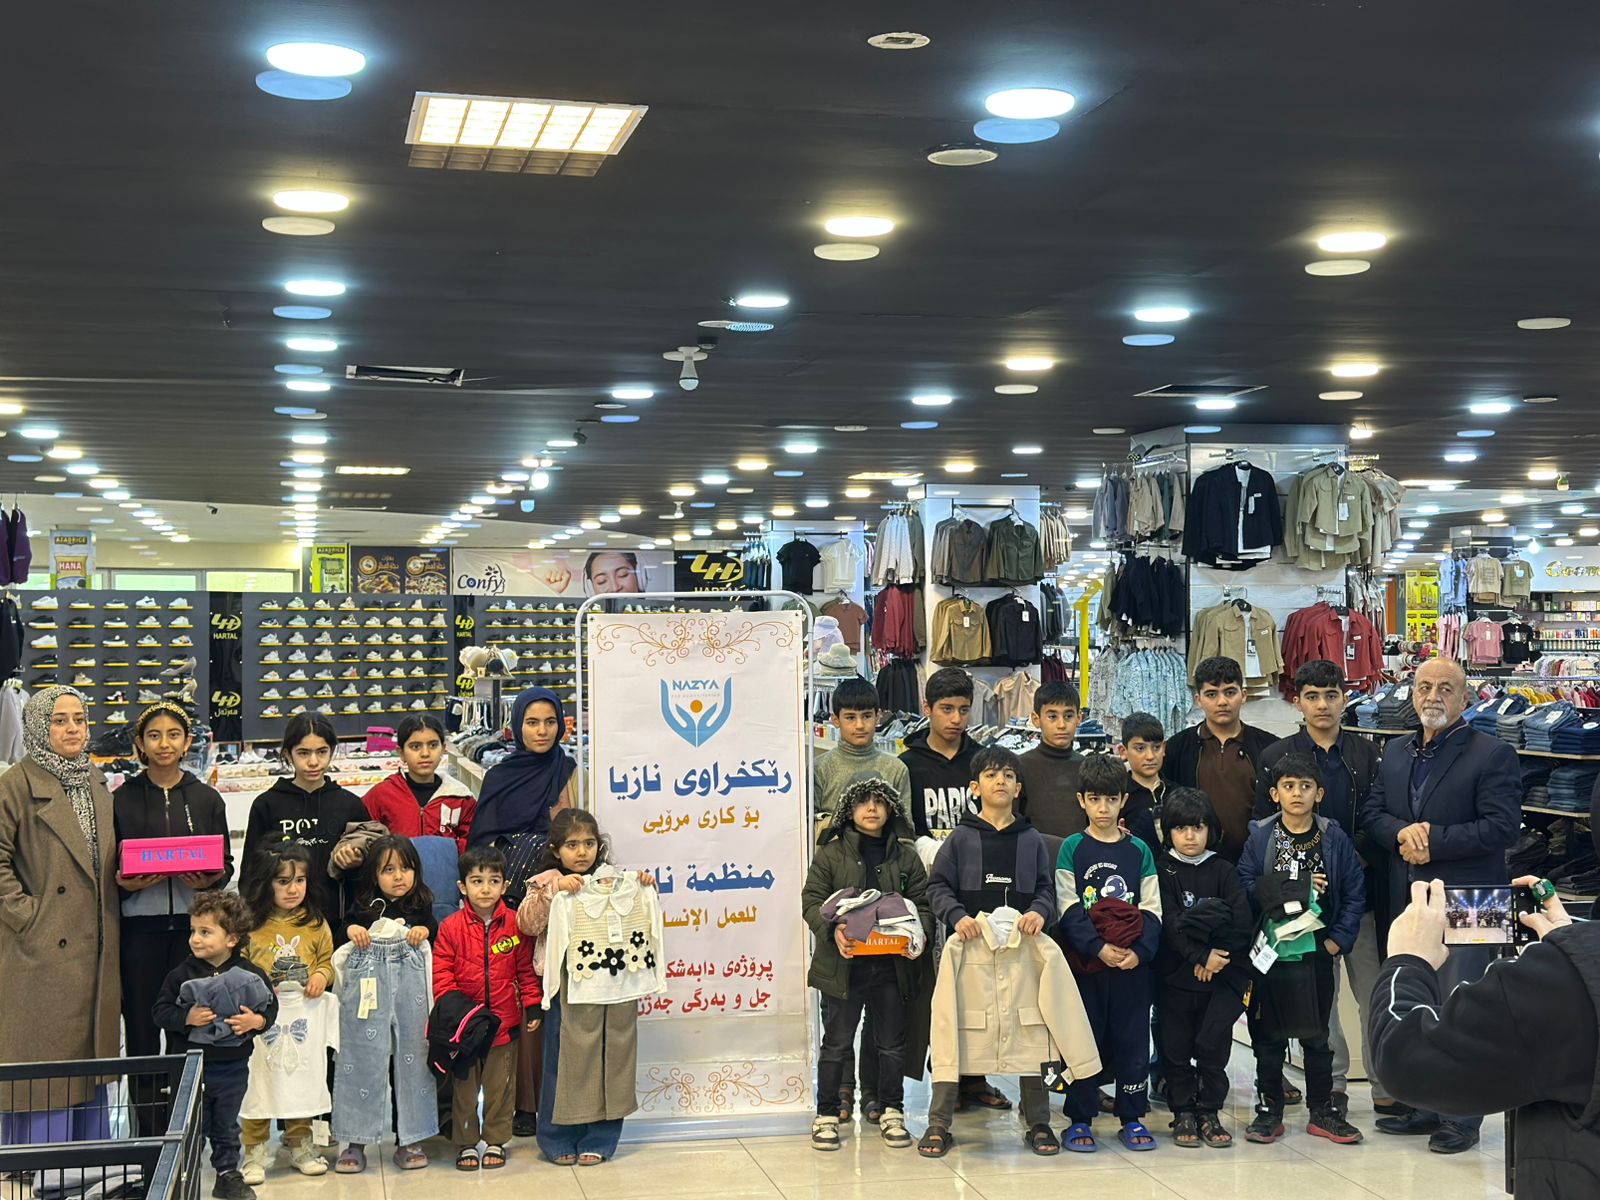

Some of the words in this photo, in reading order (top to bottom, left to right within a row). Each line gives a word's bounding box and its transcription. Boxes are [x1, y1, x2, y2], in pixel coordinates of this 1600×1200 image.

[59, 562, 82, 570] HANA
[457, 574, 502, 593] Confy
[213, 632, 238, 640] HARTAL
[672, 679, 719, 691] NAZYA
[697, 806, 735, 829] کاری
[741, 806, 760, 829] بۆ
[923, 786, 978, 829] PARIS
[141, 847, 208, 862] HARTAL
[686, 862, 775, 893] منظمة
[663, 907, 708, 932] الإنسا
[717, 904, 757, 929] للعمل
[865, 938, 900, 946] HARTAL
[665, 959, 715, 982] دابەشک
[682, 988, 726, 1013] بەرگی
[732, 993, 742, 1009] و
[749, 988, 771, 1008] جل
